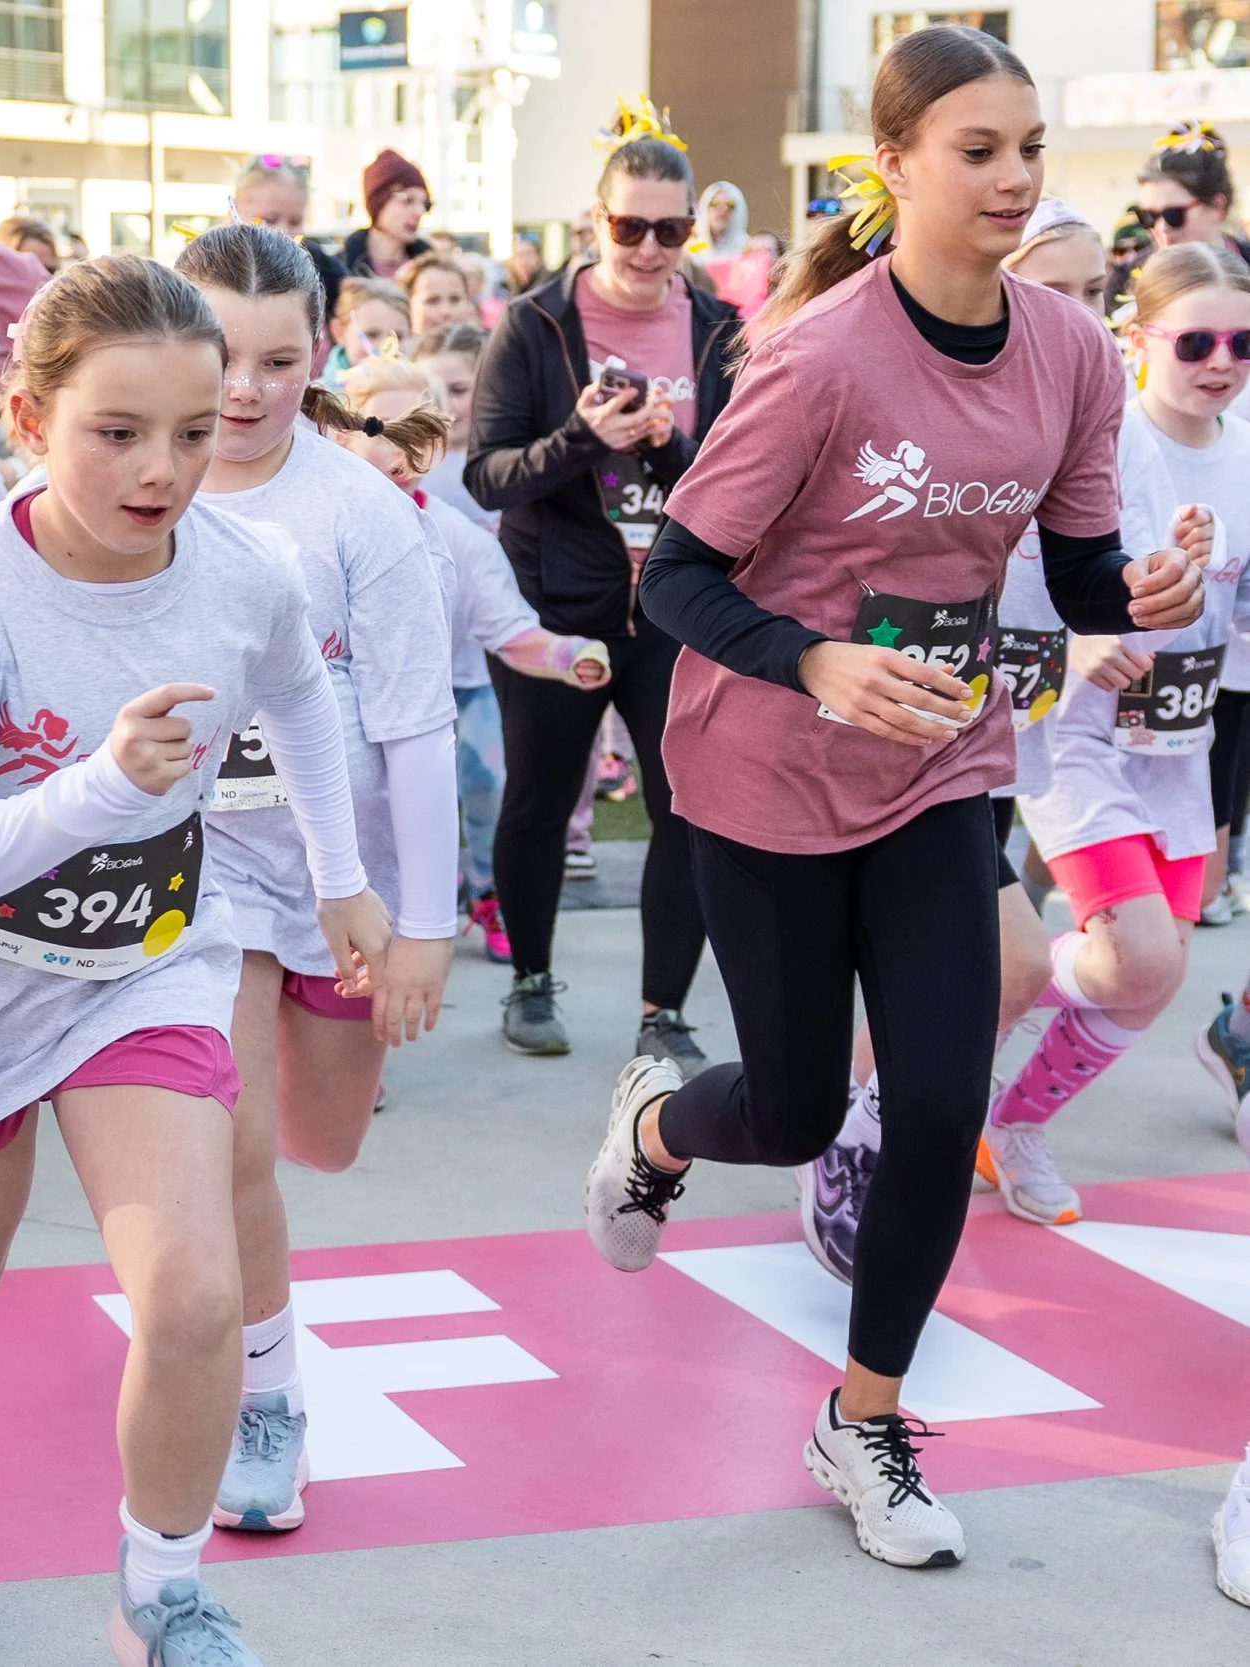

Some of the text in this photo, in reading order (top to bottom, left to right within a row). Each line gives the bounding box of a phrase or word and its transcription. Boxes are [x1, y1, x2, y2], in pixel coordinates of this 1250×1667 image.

[621, 483, 664, 516] 34
[923, 478, 1050, 519] BIOGirl
[899, 644, 970, 689] 52
[999, 663, 1042, 699] 57
[221, 790, 237, 800] ND
[37, 882, 153, 934] 394
[76, 959, 96, 968] ND
